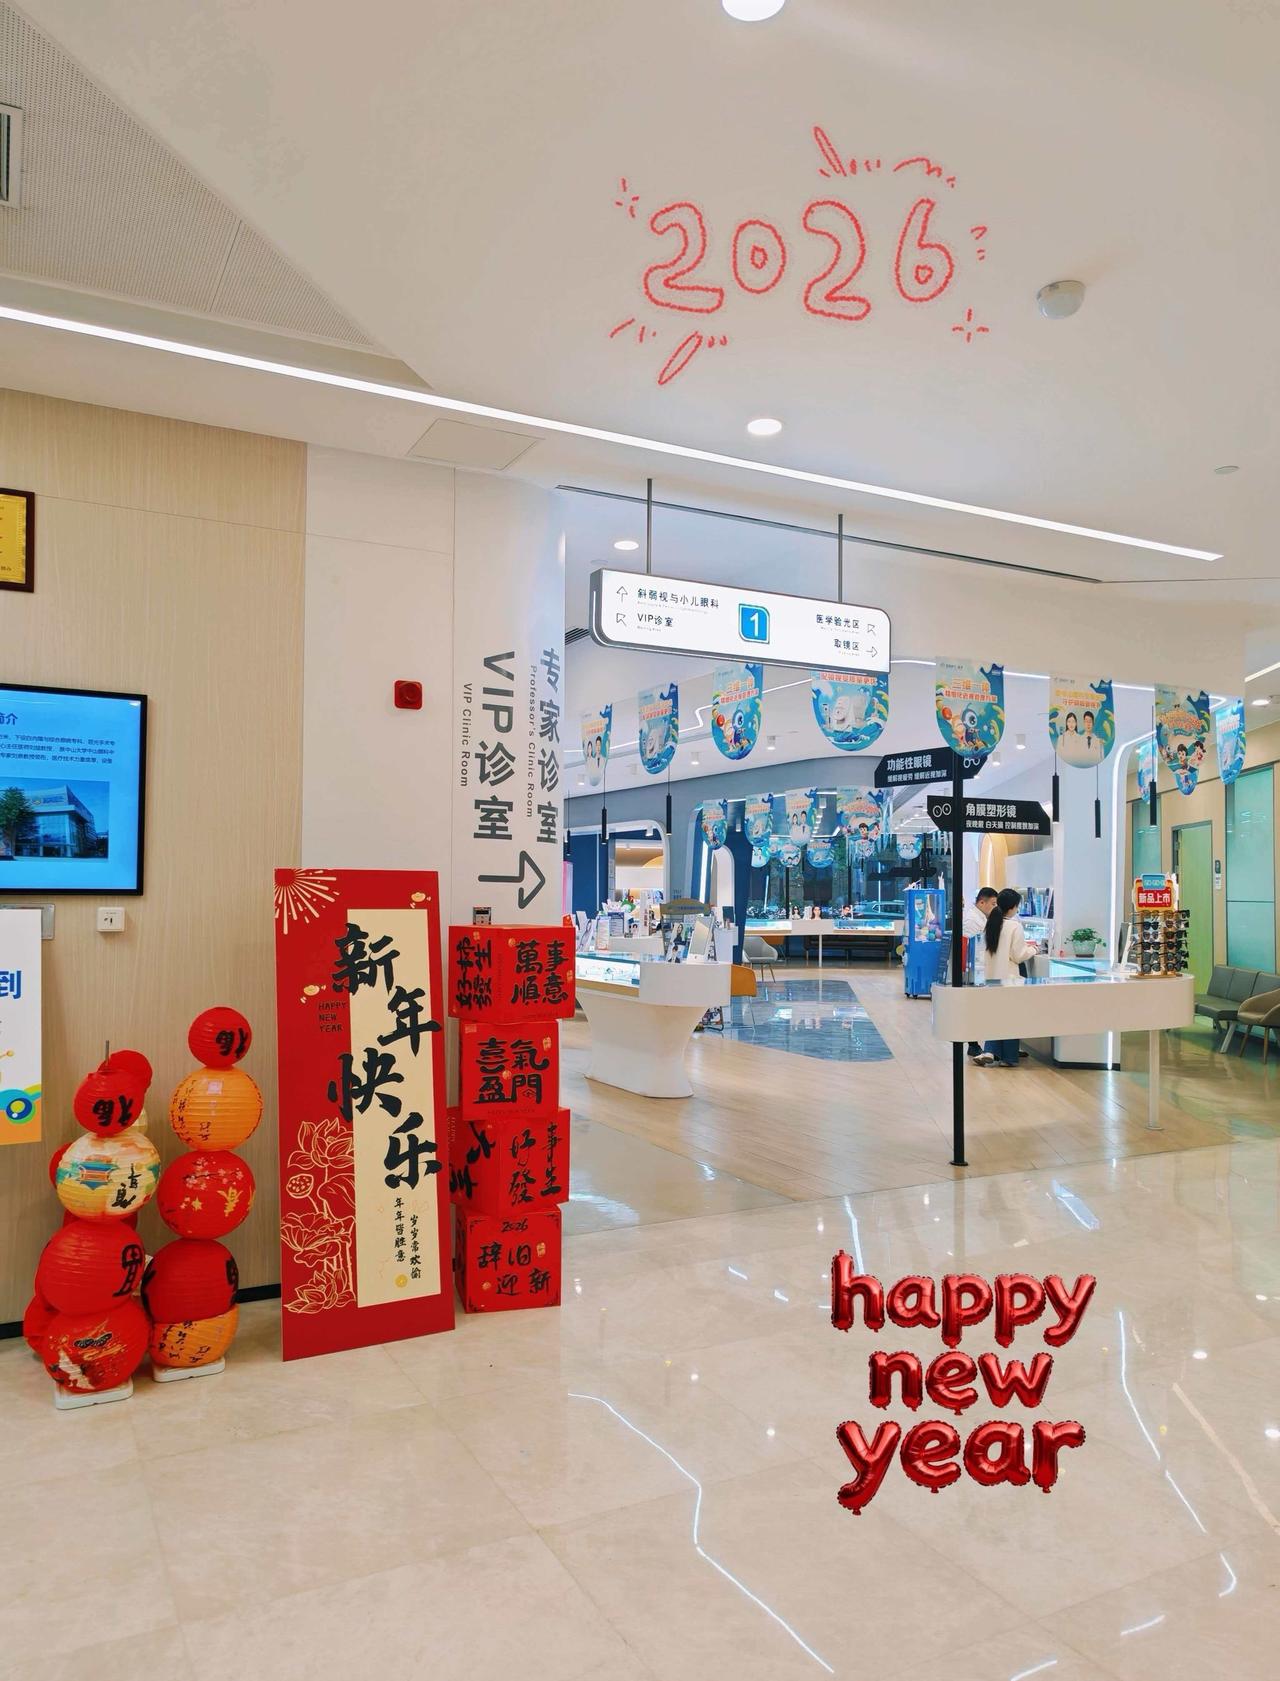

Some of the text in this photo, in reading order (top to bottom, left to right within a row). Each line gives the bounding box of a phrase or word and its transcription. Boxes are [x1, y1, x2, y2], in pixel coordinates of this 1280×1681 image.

[637, 588, 719, 609] 斜弱视与小儿眼科
[637, 612, 673, 628] VIP诊室
[750, 612, 759, 638] 1
[816, 614, 859, 629] 医学验光区
[834, 638, 859, 651] 取镜区
[460, 682, 473, 788] VIP Clinic Room
[526, 665, 537, 818] Professor's Clinic Room
[473, 650, 516, 841] VIP诊室
[537, 648, 561, 844] 专家诊室
[887, 754, 932, 771] 功能性眼镜
[966, 803, 1017, 818] 角膜塑形镜
[1139, 893, 1170, 904] 新品上市
[318, 1001, 346, 1010] HAPPY
[319, 1013, 337, 1021] NEW
[320, 1023, 343, 1032] YEAR
[327, 922, 442, 1190] 新年快乐
[501, 1218, 528, 1232] 2026
